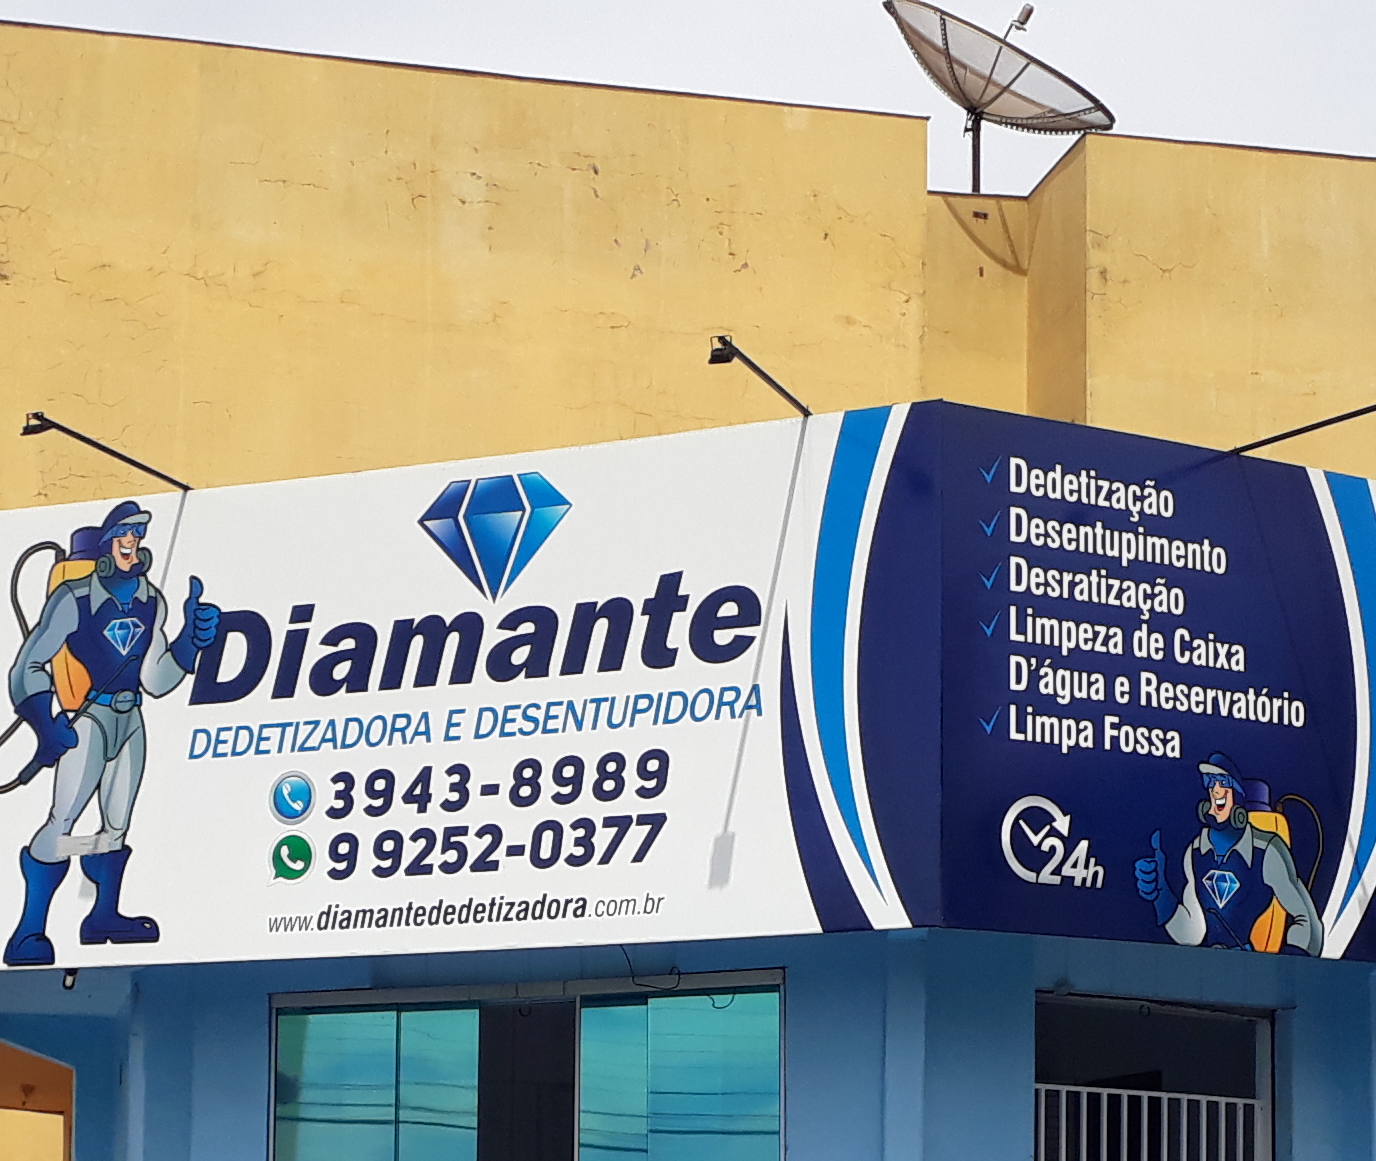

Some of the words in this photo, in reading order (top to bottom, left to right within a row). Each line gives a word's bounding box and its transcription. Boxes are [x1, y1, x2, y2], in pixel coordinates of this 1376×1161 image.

[1009, 456, 1174, 521] Dedetização
[1009, 506, 1226, 574] Desentupimento
[1009, 556, 1185, 620] Desratização
[187, 569, 763, 706] Diamante
[1009, 606, 1123, 655] Limpeza
[1133, 627, 1164, 659] de
[1174, 628, 1245, 672] Caixa
[187, 712, 433, 762] DEDETIZADORA
[443, 707, 463, 740] E
[474, 682, 764, 739] DESENTUPIDORA
[1009, 655, 1105, 705] D'água
[1115, 676, 1130, 702] e
[1140, 671, 1306, 728] Reservatório
[1009, 704, 1093, 753] Limpa
[1104, 715, 1181, 758] Fossa
[325, 748, 670, 819] 3943-8989
[327, 831, 360, 881] 9
[372, 812, 668, 878] 9252-0377
[1038, 837, 1106, 889] 24h
[268, 891, 665, 935] www.diamantededetizadora.com.br
